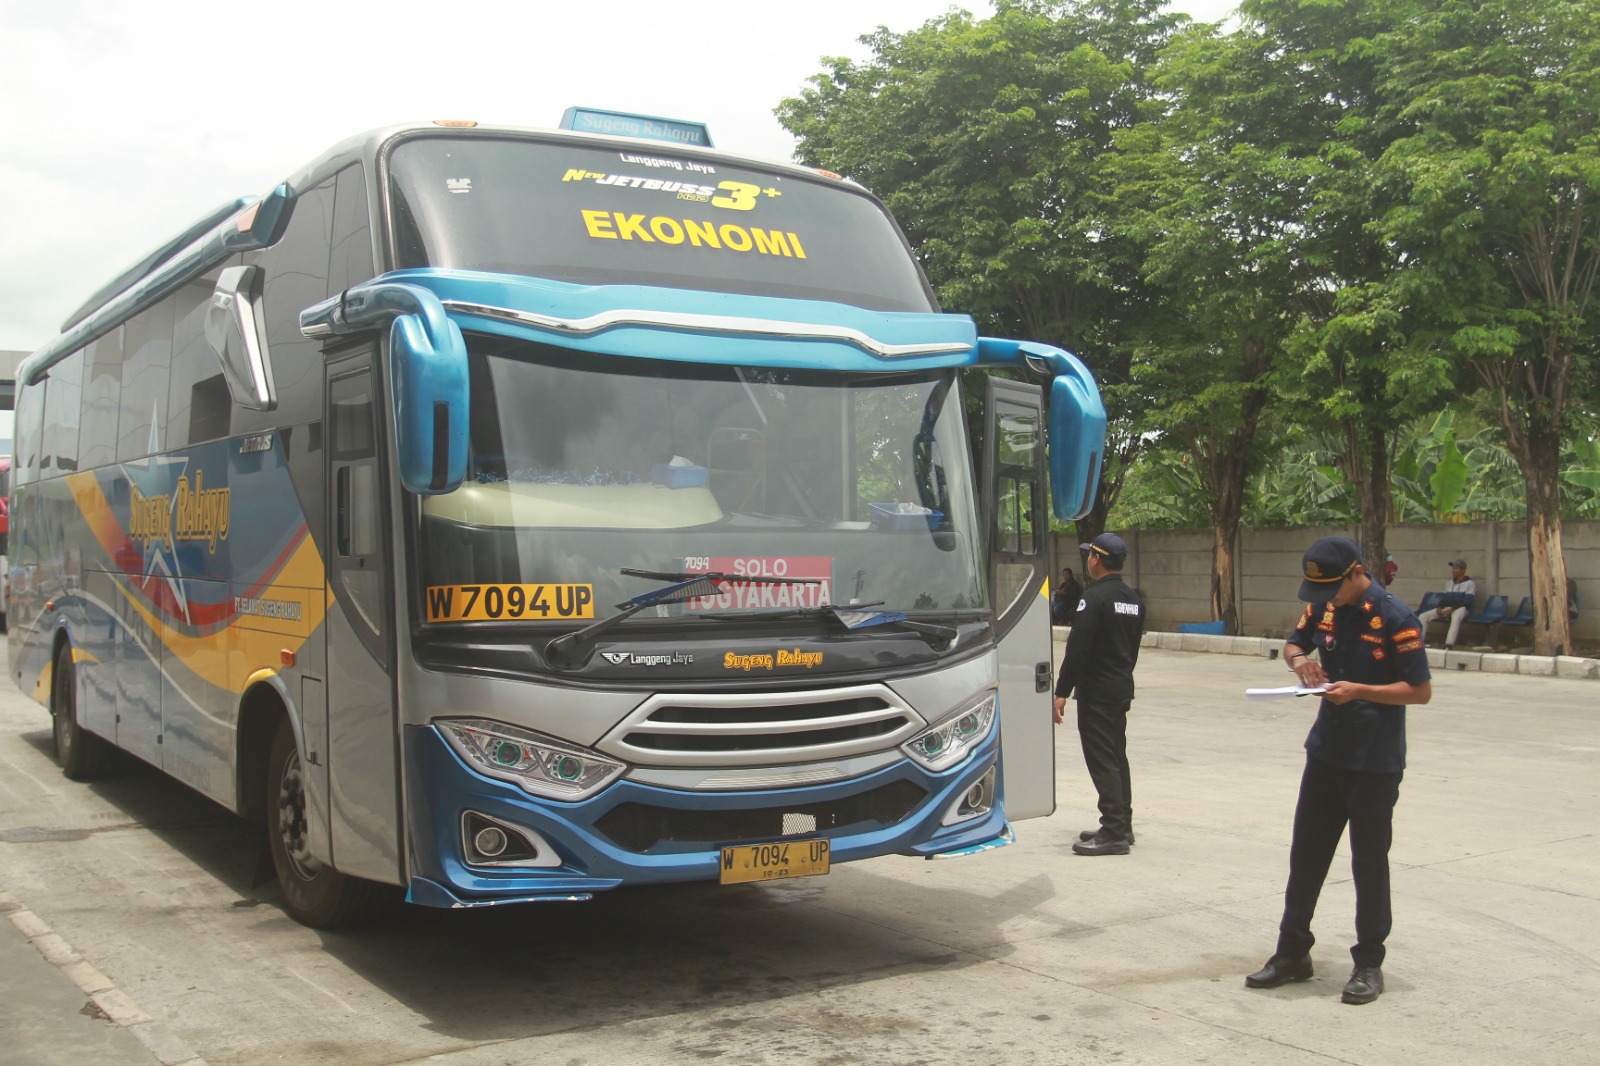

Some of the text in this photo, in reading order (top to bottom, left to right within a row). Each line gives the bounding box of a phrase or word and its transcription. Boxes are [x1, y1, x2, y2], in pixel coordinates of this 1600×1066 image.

[583, 113, 700, 144] Sugeng Rahayu
[619, 152, 716, 175] Langgeng Jaya
[580, 209, 807, 260] EKONOMI
[685, 556, 709, 570] 7094
[733, 558, 788, 577] SOLO
[630, 652, 693, 666] Langgeng Jaya
[723, 841, 828, 870] W 7094 UP
